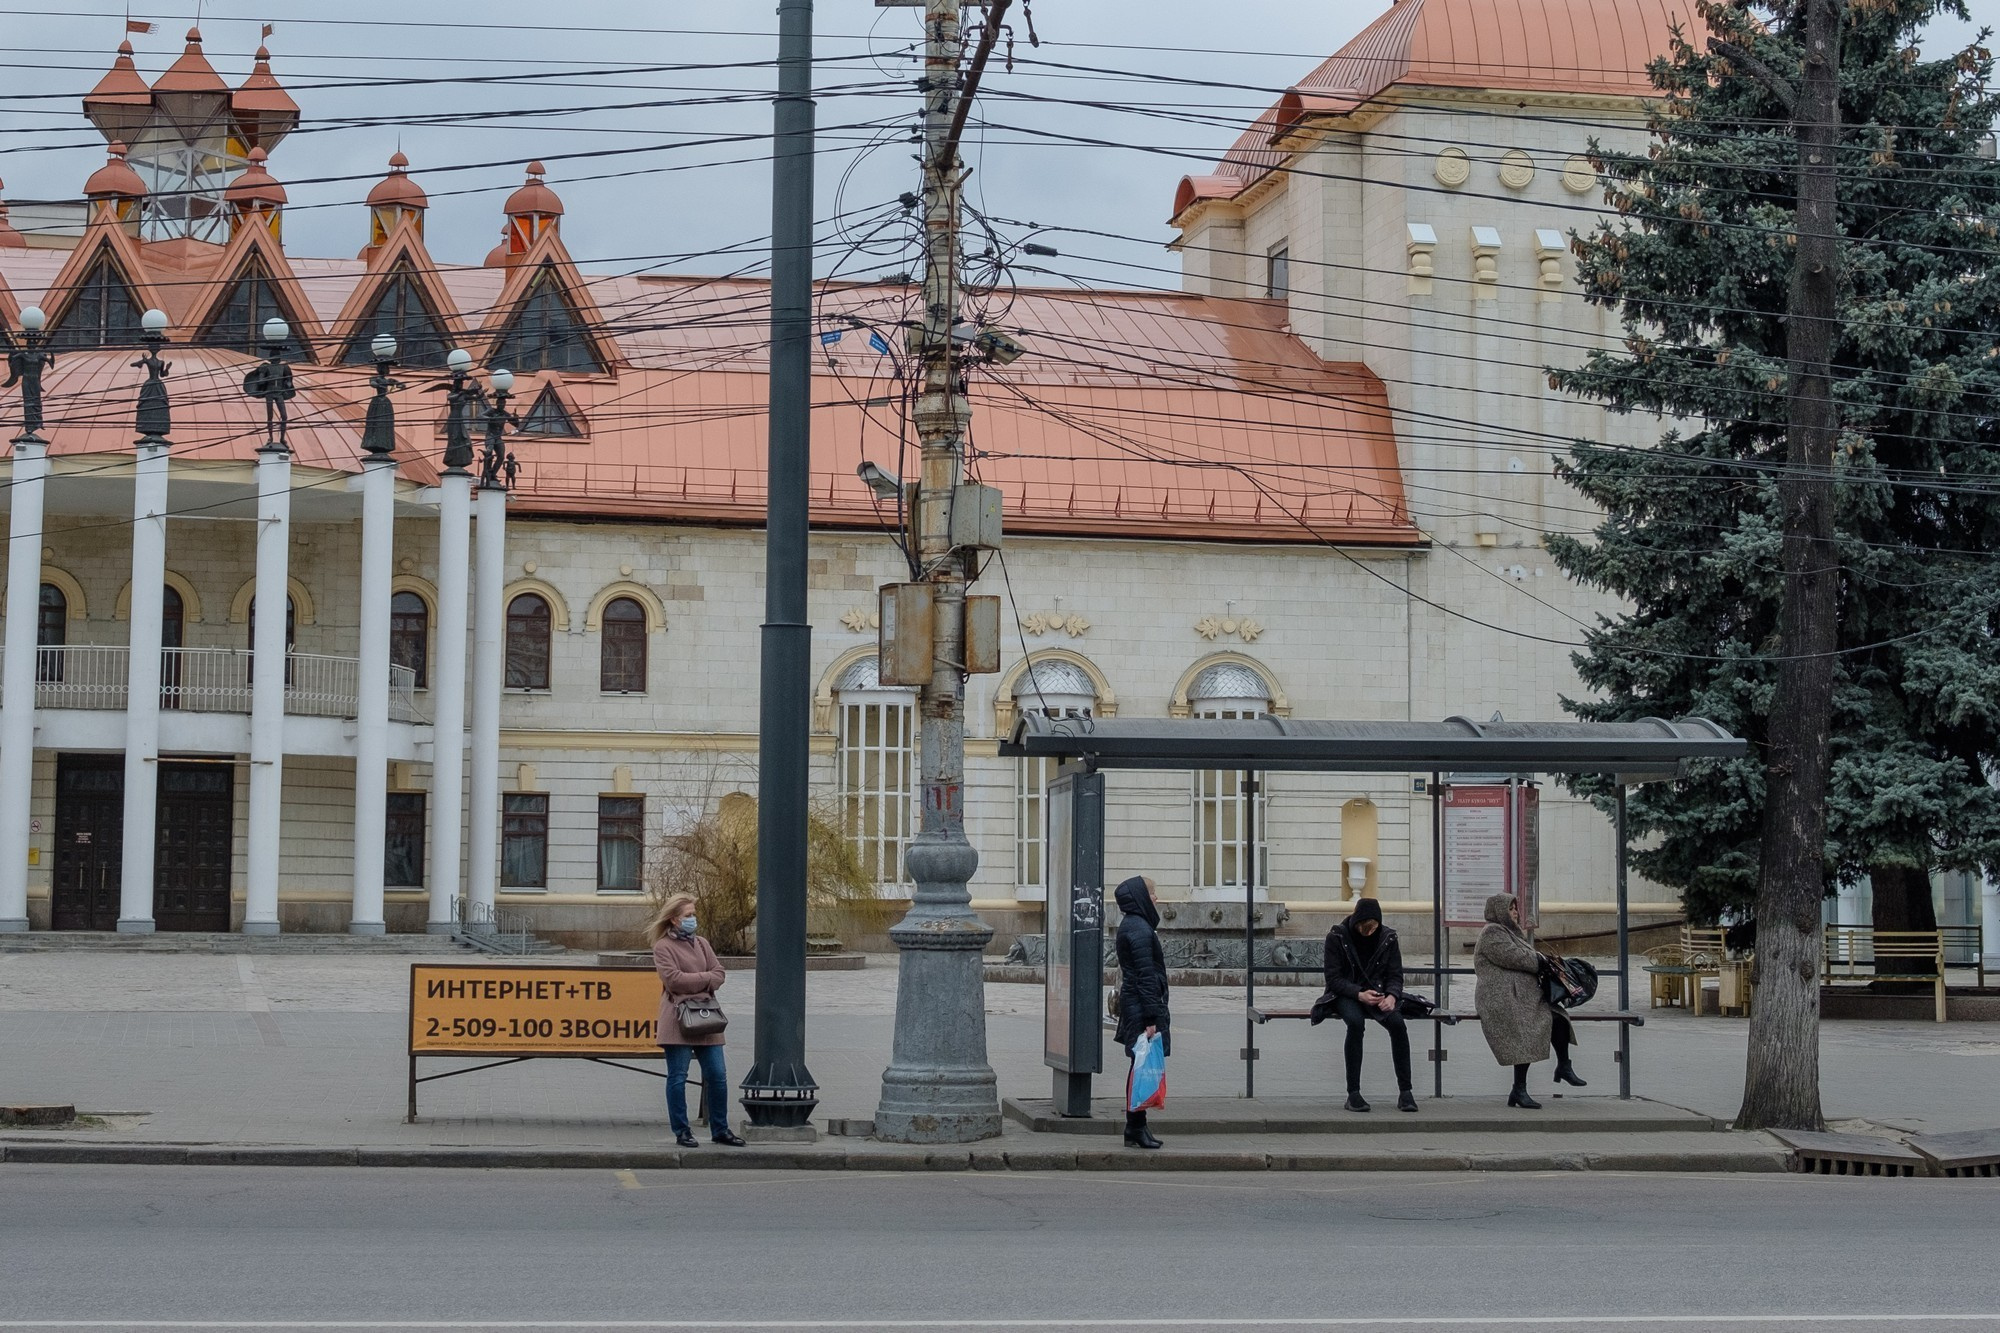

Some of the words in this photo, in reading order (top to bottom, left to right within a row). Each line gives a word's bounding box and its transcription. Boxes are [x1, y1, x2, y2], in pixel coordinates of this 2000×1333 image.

[427, 979, 612, 1001] ИНТЕРНЕТ+ТВ
[426, 1017, 553, 1039] 2-509-100
[559, 1019, 658, 1039] ЗВОНИ!
